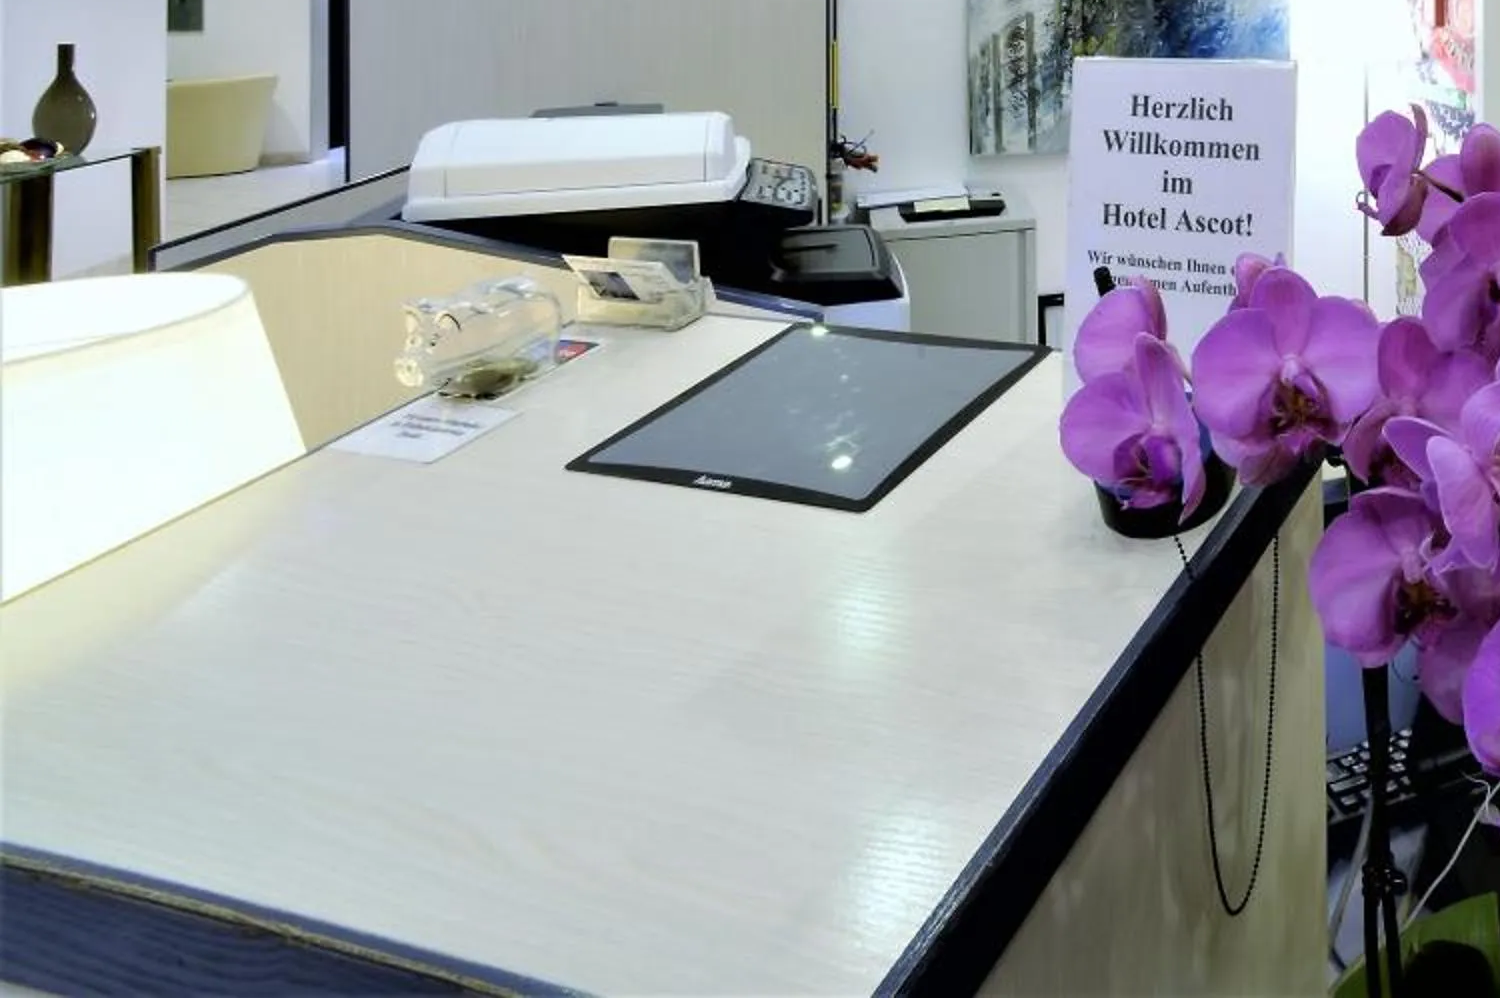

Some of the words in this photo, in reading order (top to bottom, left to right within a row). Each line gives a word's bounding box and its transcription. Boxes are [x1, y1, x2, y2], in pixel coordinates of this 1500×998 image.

[1130, 94, 1234, 121] Herzlich
[1102, 129, 1260, 161] Willkommen
[1161, 169, 1193, 194] im
[1102, 203, 1167, 231] Hotel
[1174, 209, 1253, 237] Ascot!
[1087, 250, 1112, 265] Wir
[1117, 253, 1182, 271] wünschen
[1187, 259, 1226, 275] Ihnen
[1182, 279, 1238, 296] Aufenth
